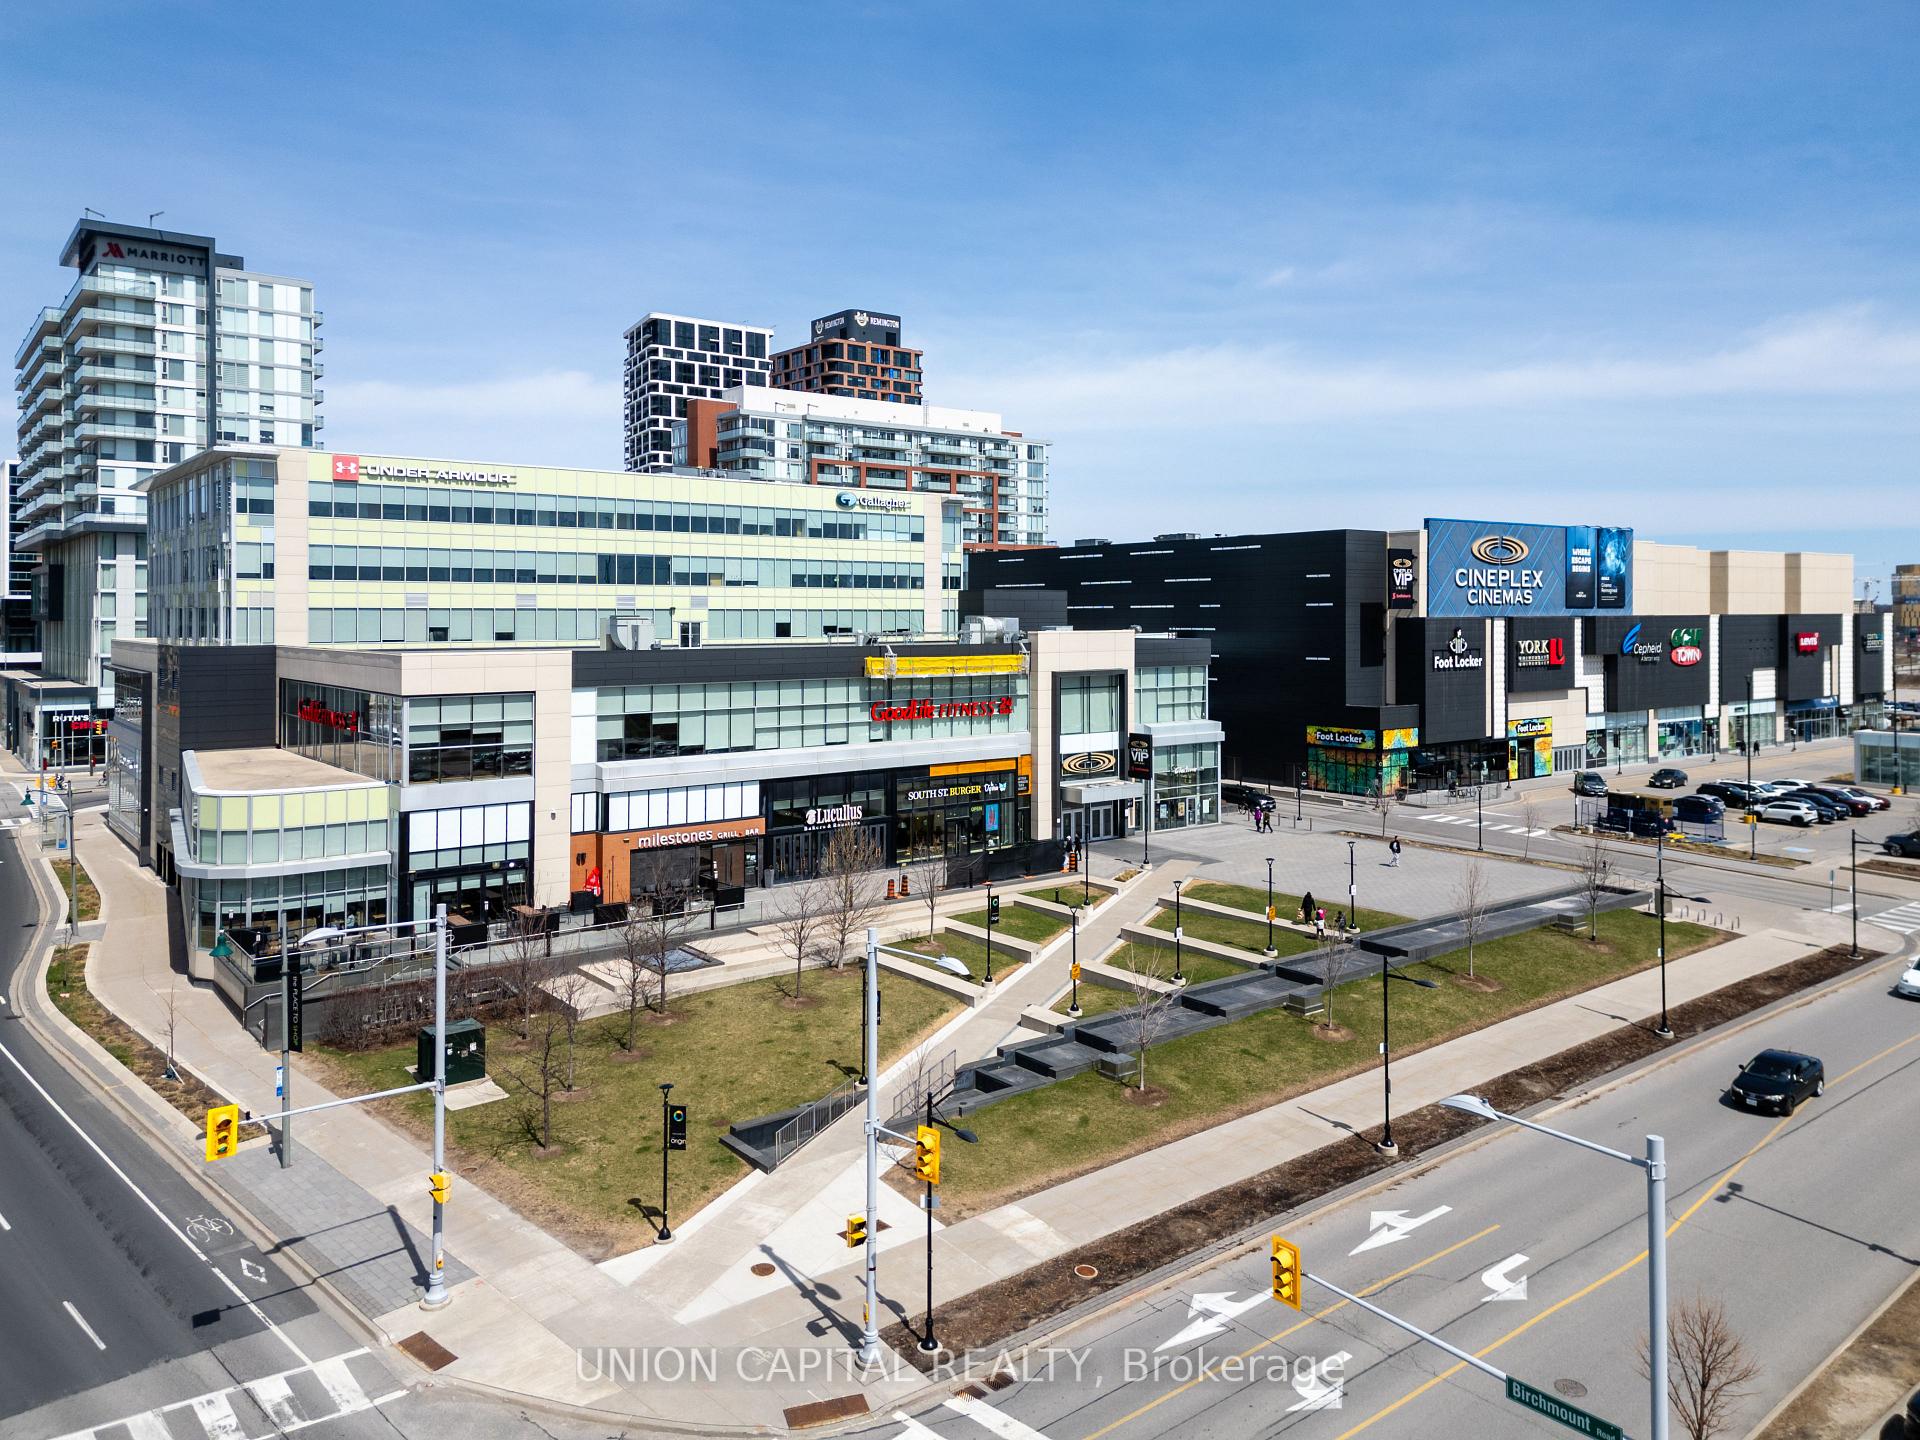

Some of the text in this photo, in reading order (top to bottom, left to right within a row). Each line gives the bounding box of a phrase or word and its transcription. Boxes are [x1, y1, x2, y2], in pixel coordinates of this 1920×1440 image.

[127, 247, 206, 266] MARRIOTT
[870, 316, 900, 329] REMINGTON
[367, 465, 512, 483] UNDER ARMOUR
[860, 495, 908, 510] Gallagher
[1572, 548, 1591, 556] WHERE
[1571, 556, 1592, 565] ESCAPE
[1571, 565, 1591, 573] BEGINS
[1393, 573, 1413, 586] VIP
[1455, 568, 1544, 588] CINEPLEX
[1467, 588, 1533, 604] CINEMAS
[1518, 640, 1549, 654] YORK
[1677, 648, 1700, 662] TOWN
[1434, 656, 1483, 669] Foot Locker
[871, 698, 935, 721] GoodLife
[938, 701, 997, 718] FITNESS
[52, 714, 89, 722] RUTH'S
[1517, 723, 1546, 733] Foot Locker
[1316, 731, 1363, 743] Foot Locker
[1131, 751, 1149, 762] VIP
[908, 788, 937, 801] SOUTH
[949, 785, 982, 797] BURGER
[816, 804, 863, 824] Lucullus
[638, 828, 760, 848] milestones GRILL BAR
[293, 1014, 299, 1024] TO
[1512, 1382, 1591, 1432] Birchmount
